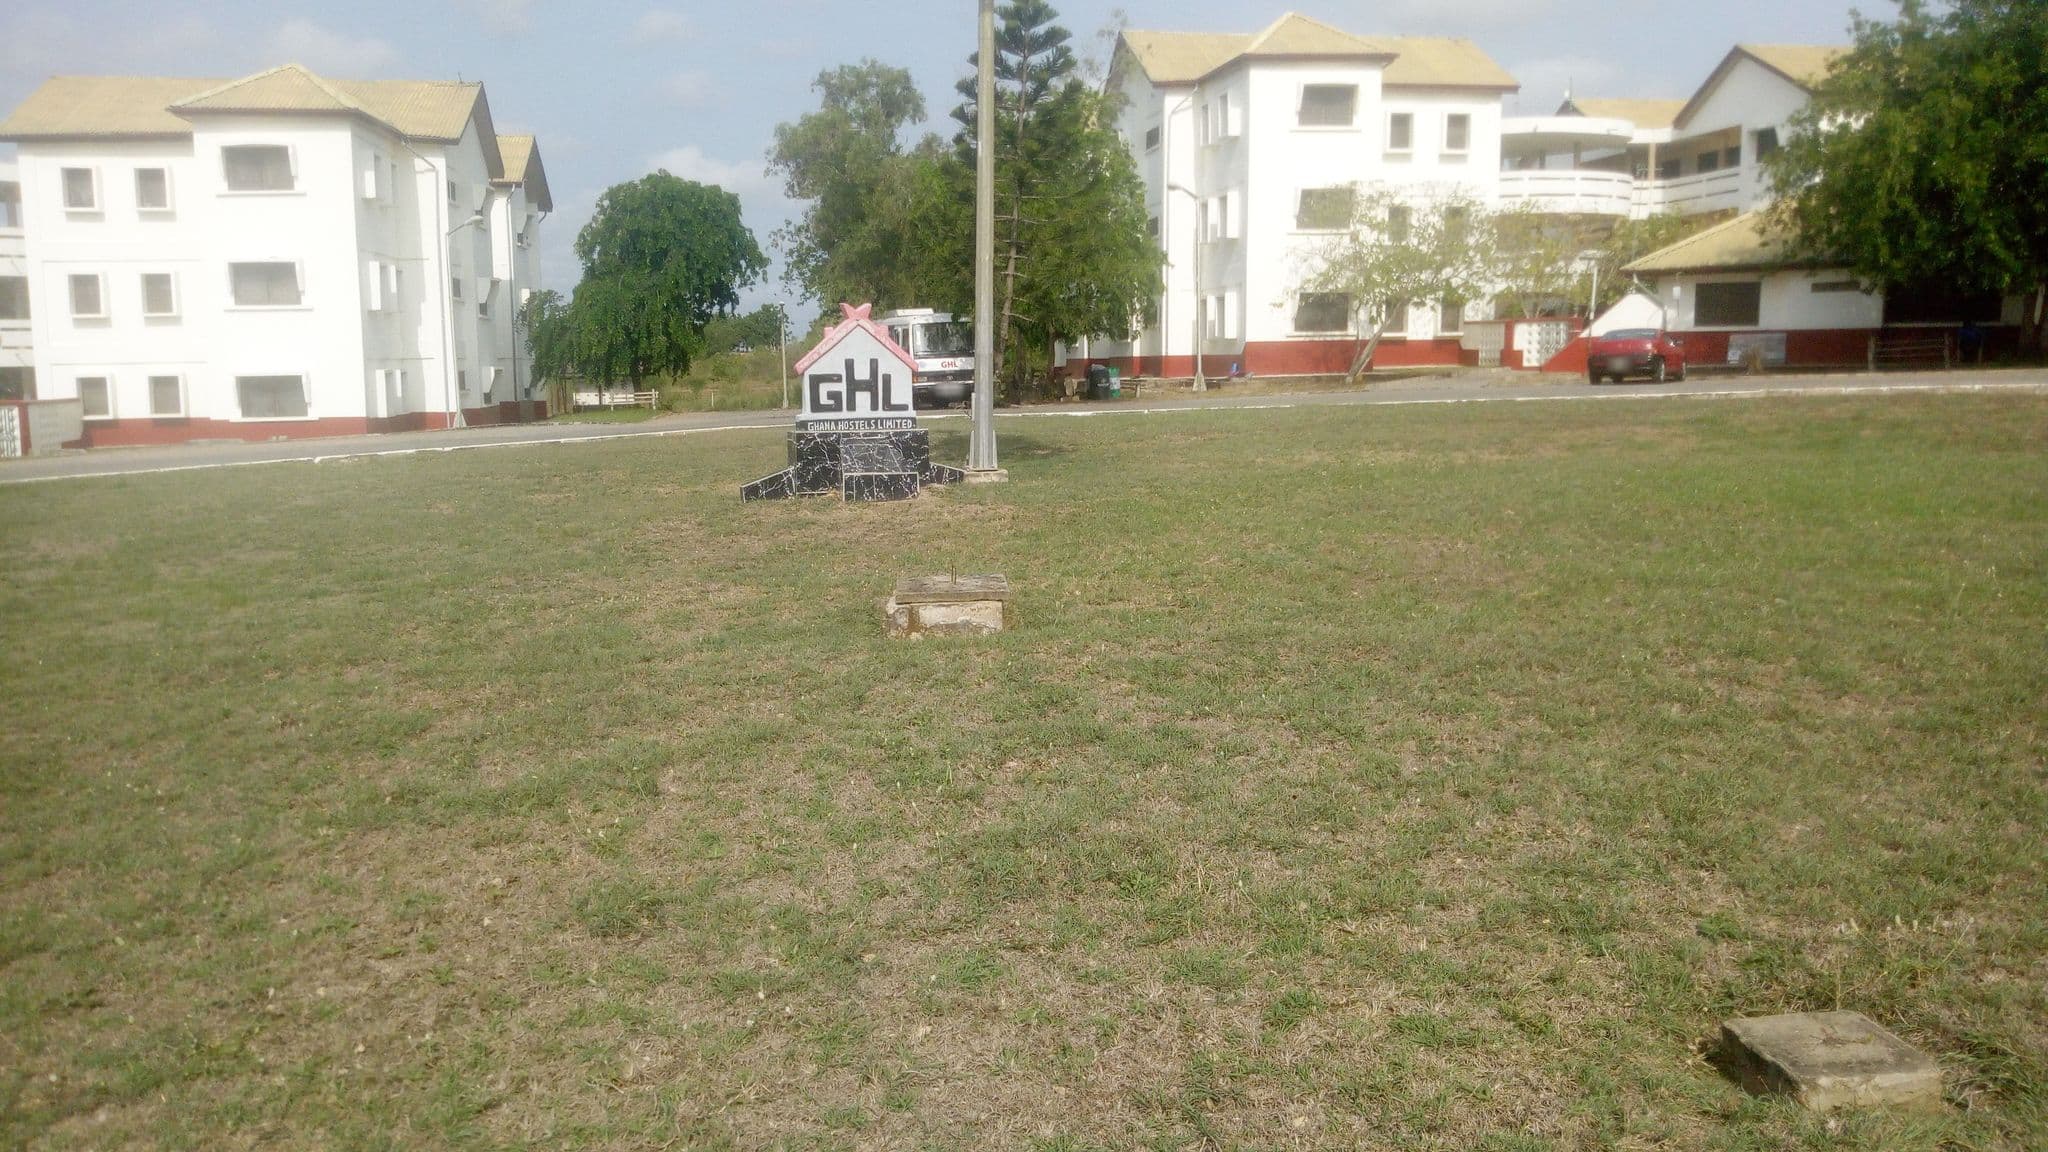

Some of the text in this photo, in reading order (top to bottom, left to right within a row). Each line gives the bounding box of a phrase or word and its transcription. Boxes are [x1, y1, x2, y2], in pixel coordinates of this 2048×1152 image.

[940, 359, 959, 369] GHL
[808, 358, 910, 413] GHL
[807, 421, 836, 431] GHANA
[838, 419, 876, 431] HOSTELS
